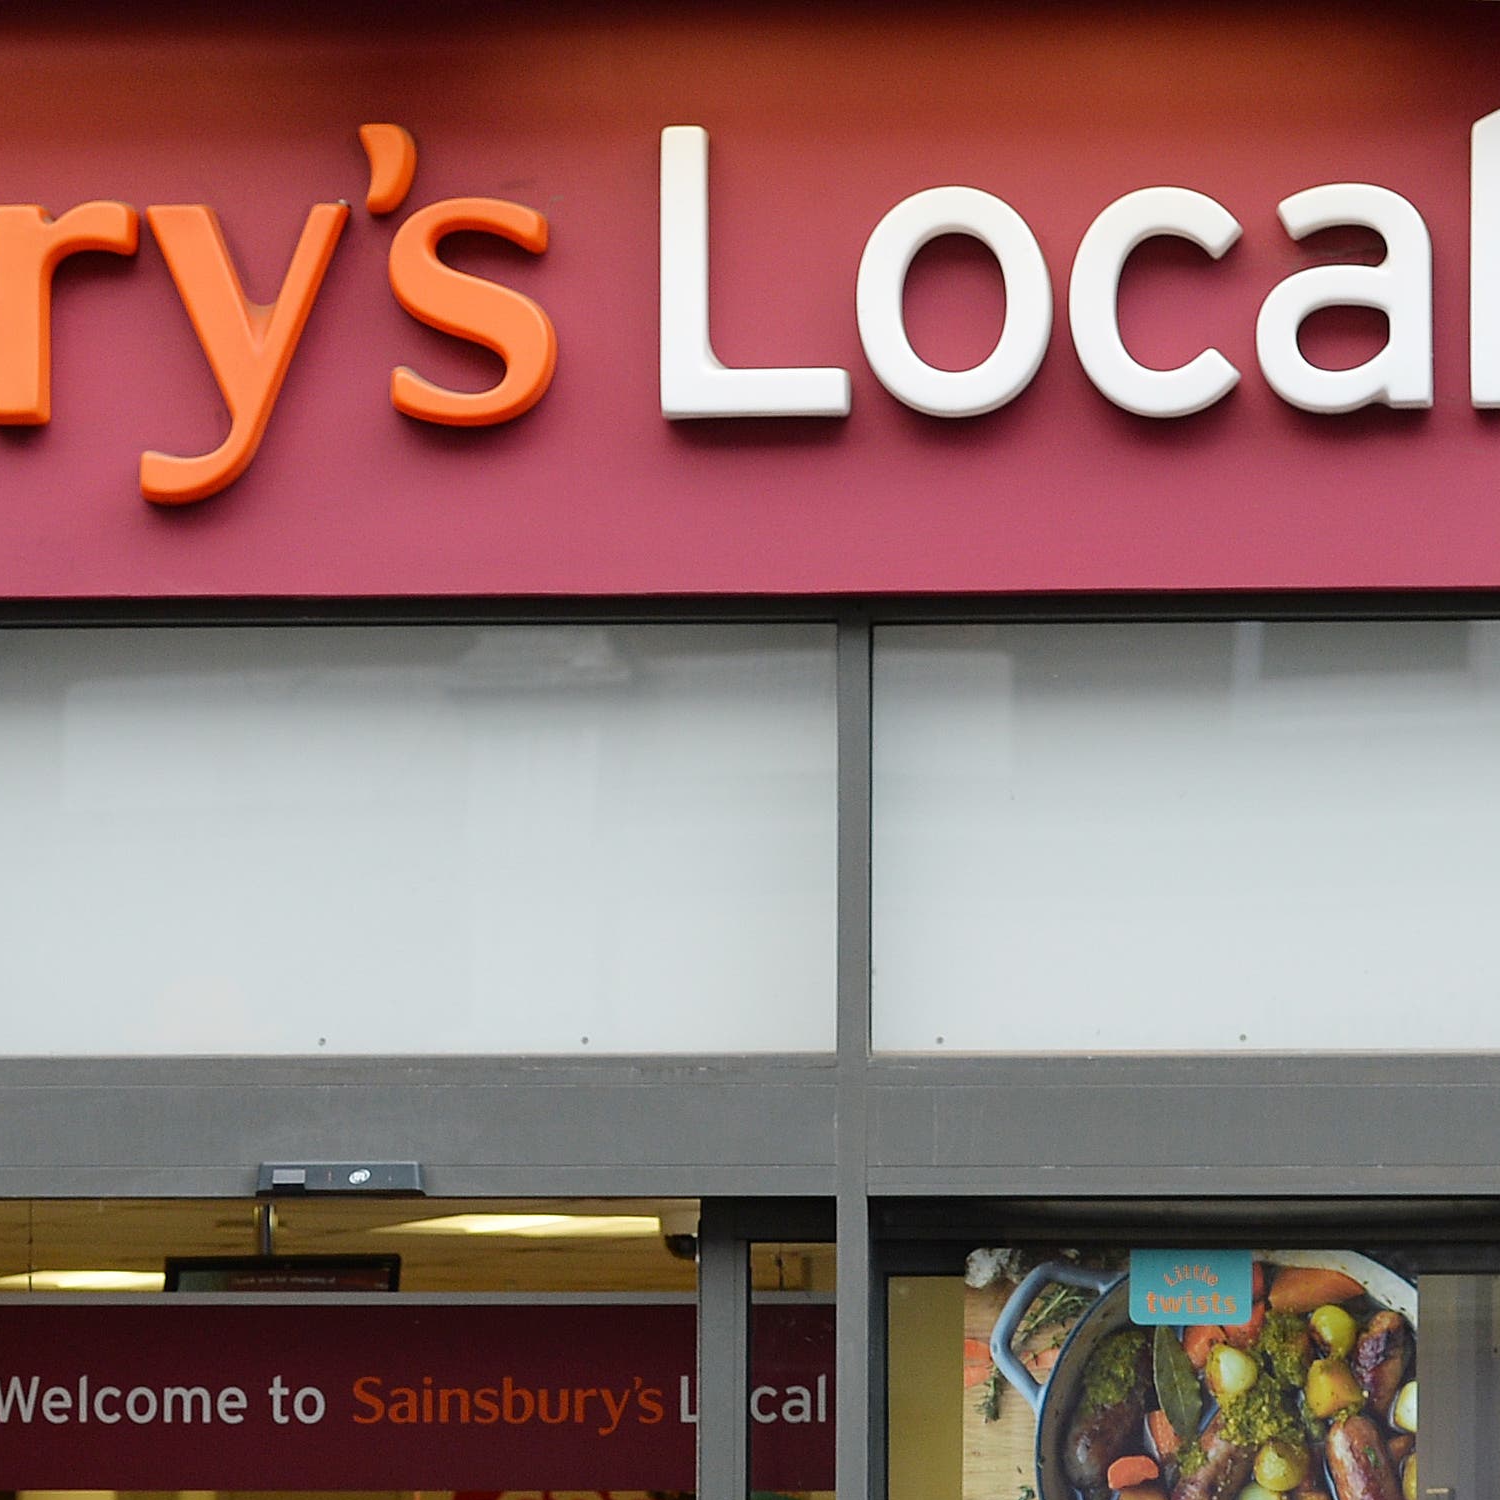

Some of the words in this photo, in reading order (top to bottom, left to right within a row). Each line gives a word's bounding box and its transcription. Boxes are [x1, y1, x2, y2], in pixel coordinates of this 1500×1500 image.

[1163, 1263, 1220, 1288] Little
[1146, 1290, 1238, 1314] twists
[268, 1375, 326, 1424] to
[352, 1376, 664, 1435] Sainsbury's
[679, 1375, 827, 1424] Lcal
